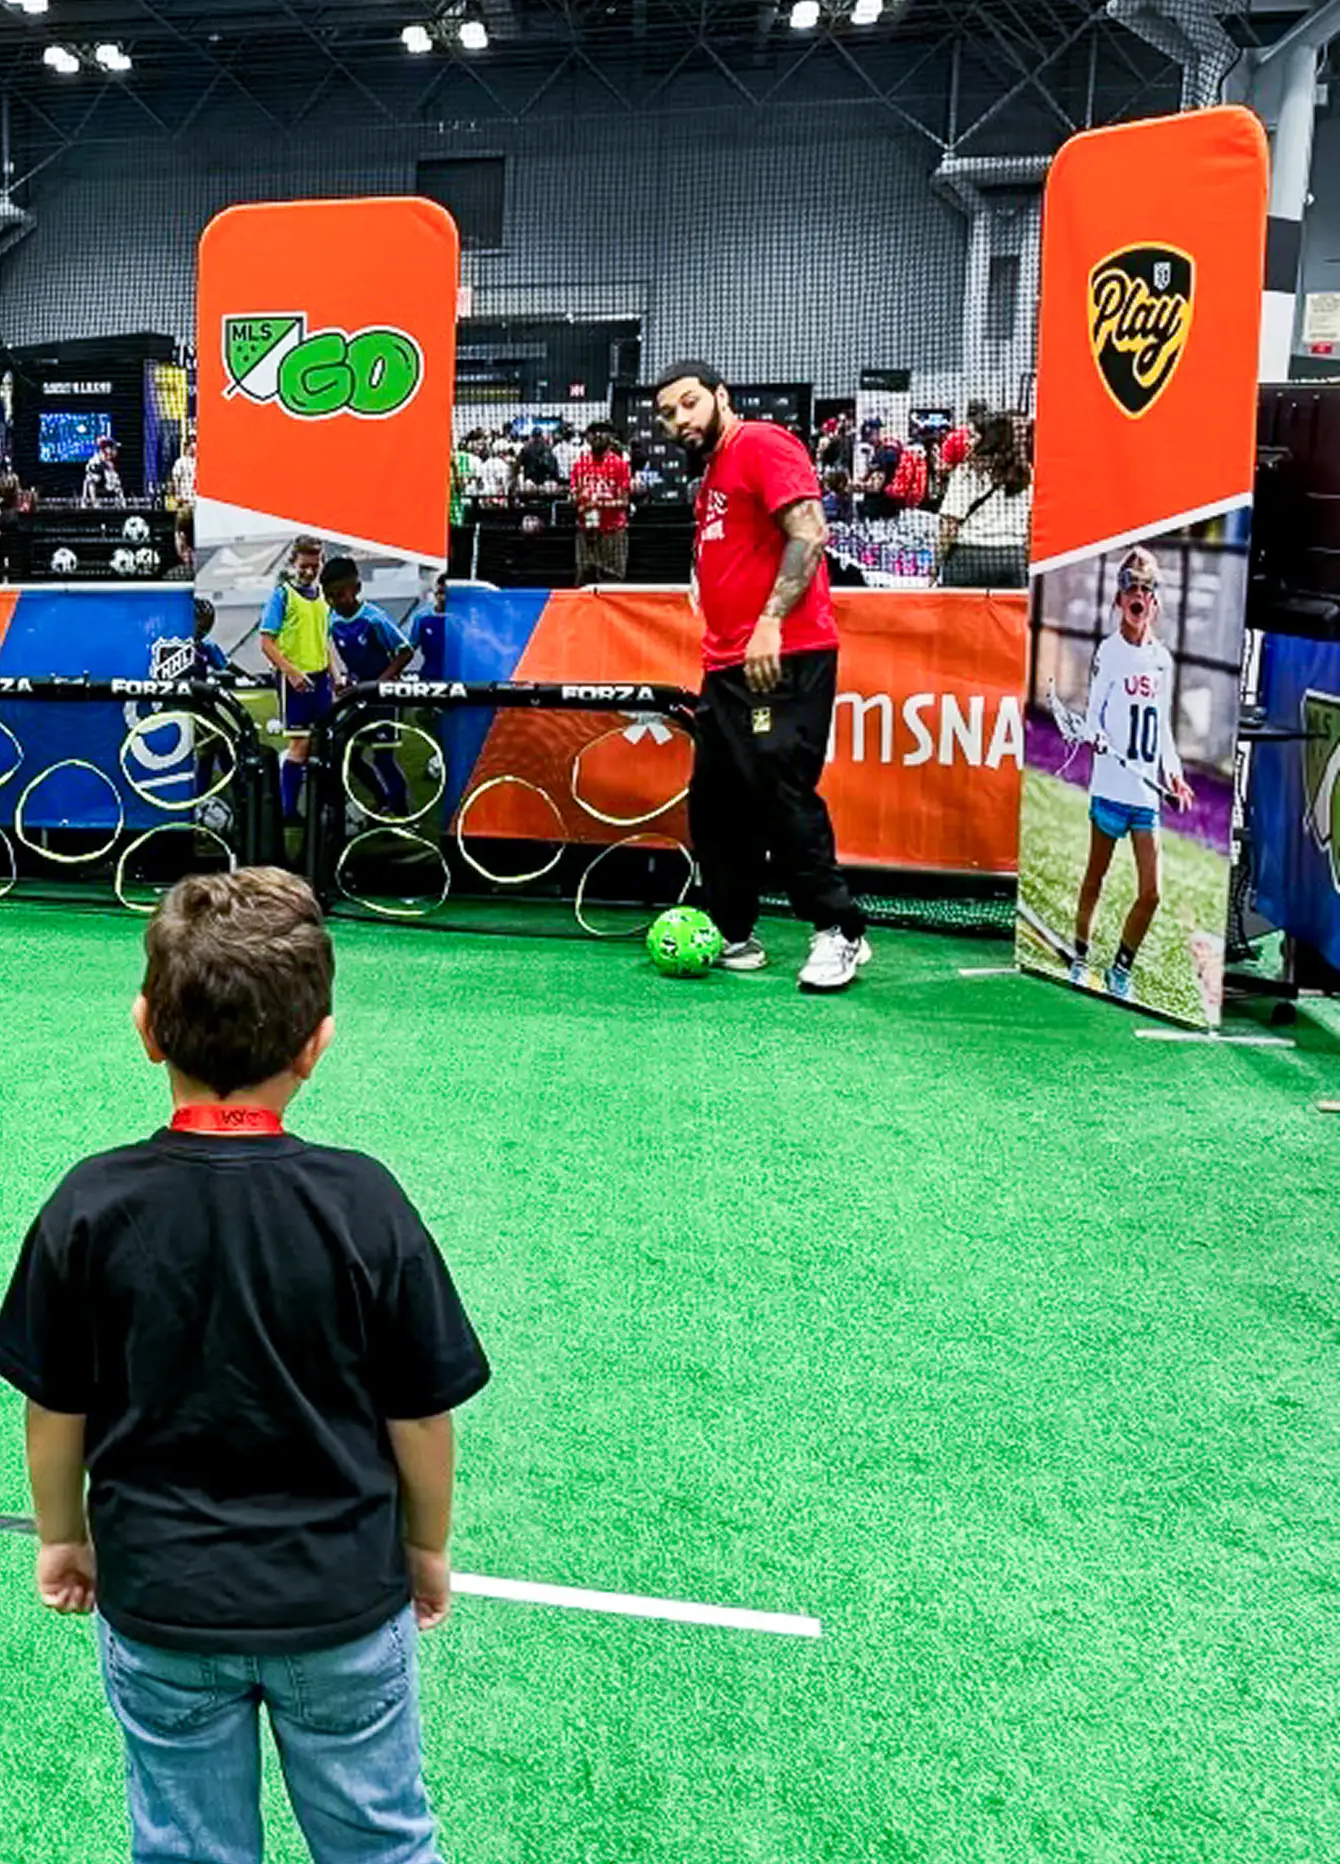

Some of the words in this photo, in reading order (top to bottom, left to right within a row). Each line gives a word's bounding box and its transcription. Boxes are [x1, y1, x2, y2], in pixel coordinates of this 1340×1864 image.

[232, 324, 273, 341] MLS
[1093, 271, 1183, 380] Play
[278, 330, 421, 416] GO
[112, 678, 193, 697] FORZA
[379, 681, 468, 698] FORZA
[562, 684, 655, 701] FORZA
[1124, 675, 1157, 698] US
[1127, 704, 1158, 763] 10
